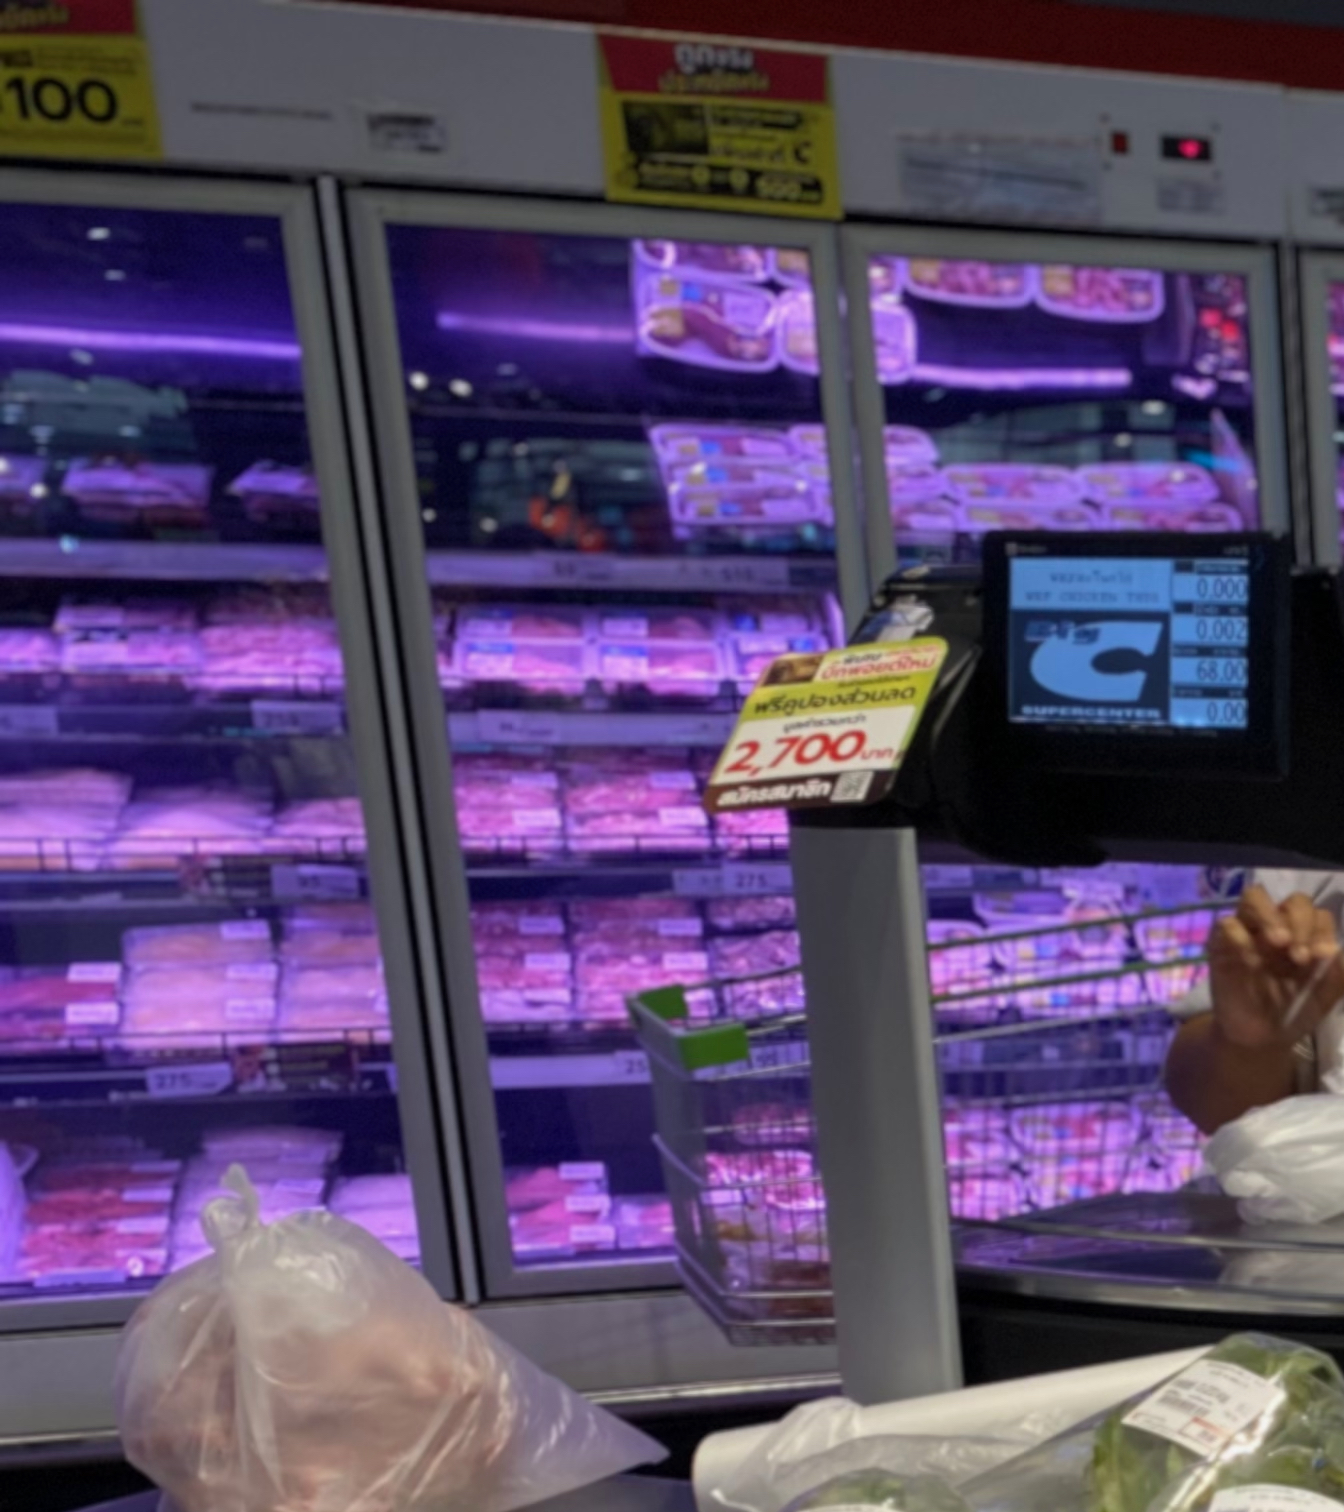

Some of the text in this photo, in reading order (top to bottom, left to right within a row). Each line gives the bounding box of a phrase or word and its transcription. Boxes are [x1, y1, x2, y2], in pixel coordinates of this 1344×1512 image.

[1196, 577, 1246, 600] 0.000
[1195, 619, 1246, 643] 0.002
[1198, 660, 1246, 683] 68.00
[754, 684, 916, 716] ฟรีคูปองส่วนลด
[1021, 705, 1161, 719] SUPERCENTER
[1206, 701, 1246, 723] 0.00
[724, 728, 867, 777] 2,700
